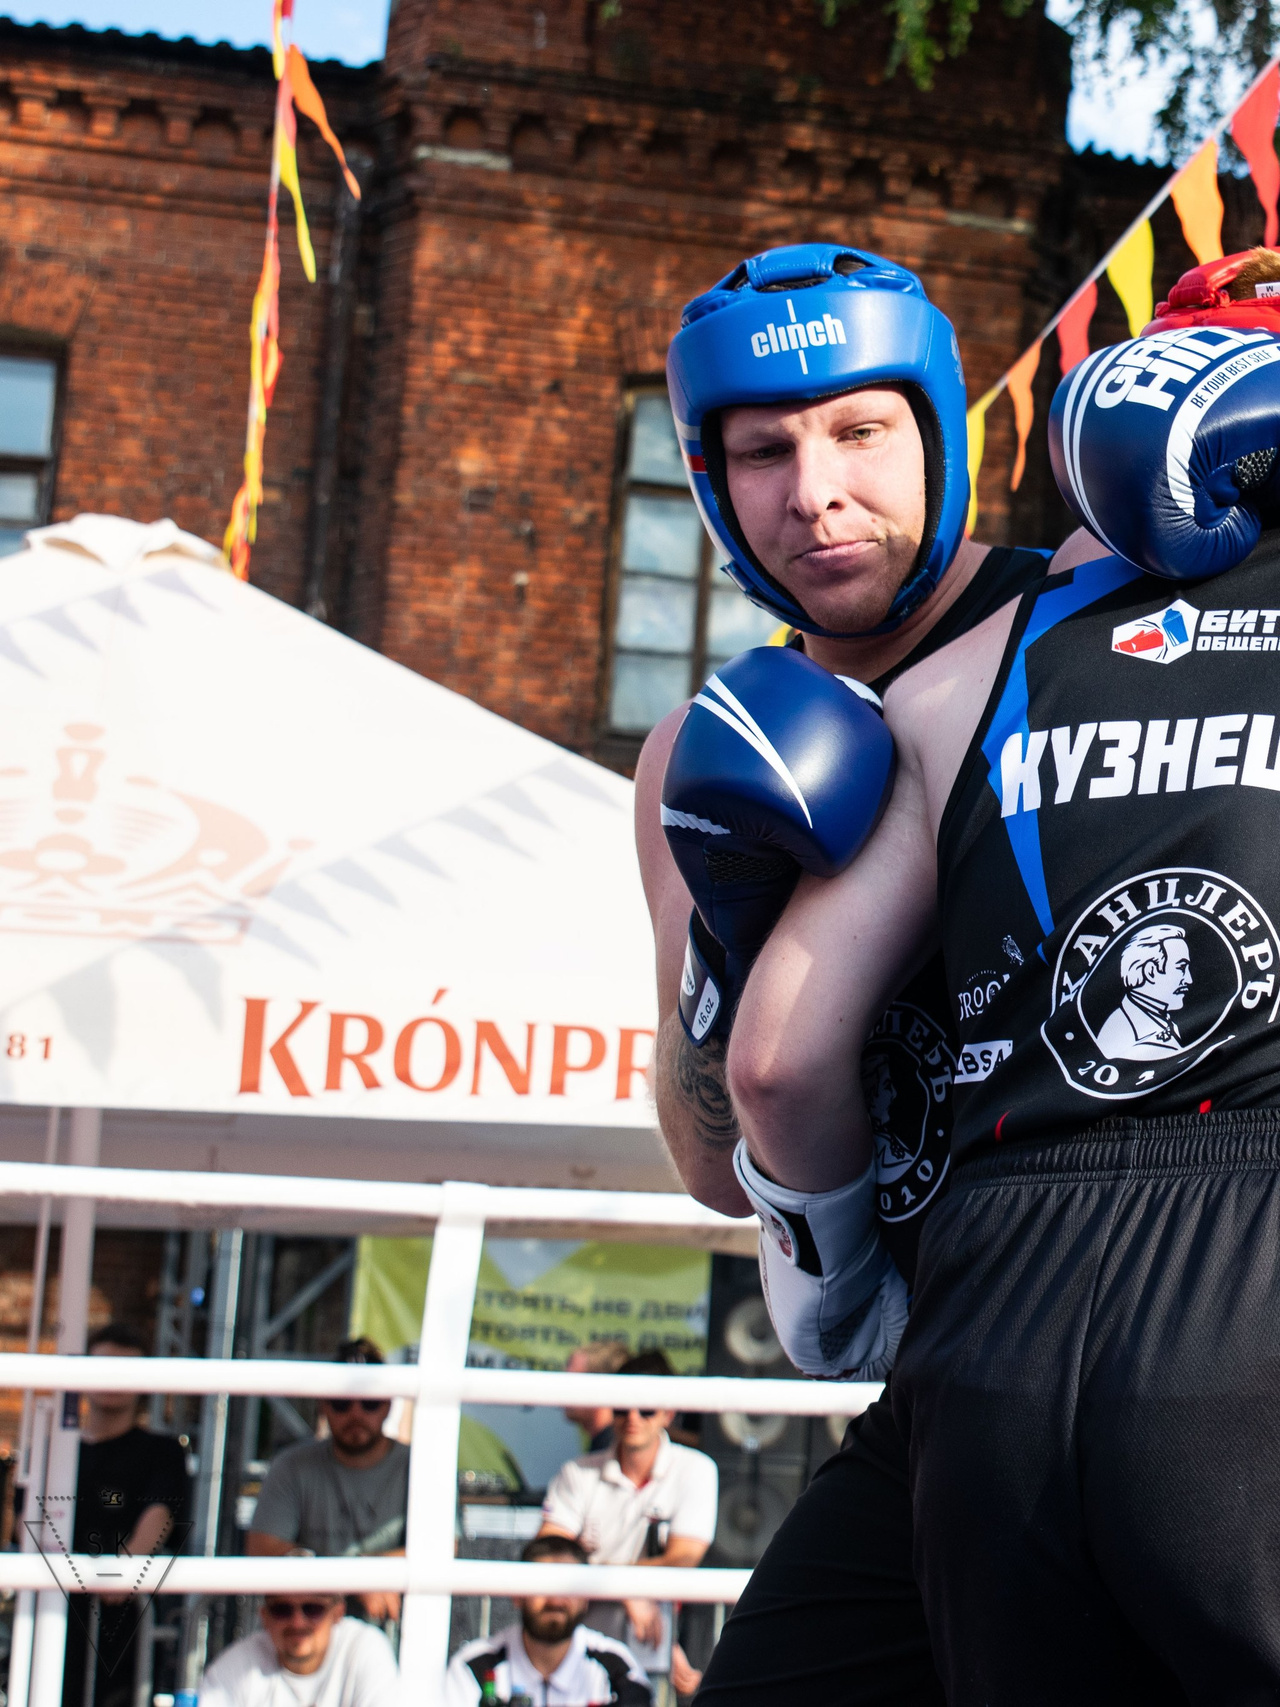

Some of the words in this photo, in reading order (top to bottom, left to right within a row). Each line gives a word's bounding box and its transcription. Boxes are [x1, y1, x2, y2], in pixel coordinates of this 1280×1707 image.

[751, 313, 847, 359] clinch
[1126, 326, 1275, 412] HILL
[1190, 392, 1209, 410] BE
[1206, 371, 1229, 397] YOUR
[1224, 357, 1253, 378] BEST
[1252, 349, 1273, 364] SELF
[1060, 878, 1275, 1010] КАНЦЛЕРЪ
[875, 1009, 953, 1103] ЛЕРЪ
[955, 1048, 1005, 1076] BSA
[880, 1159, 934, 1210] 010
